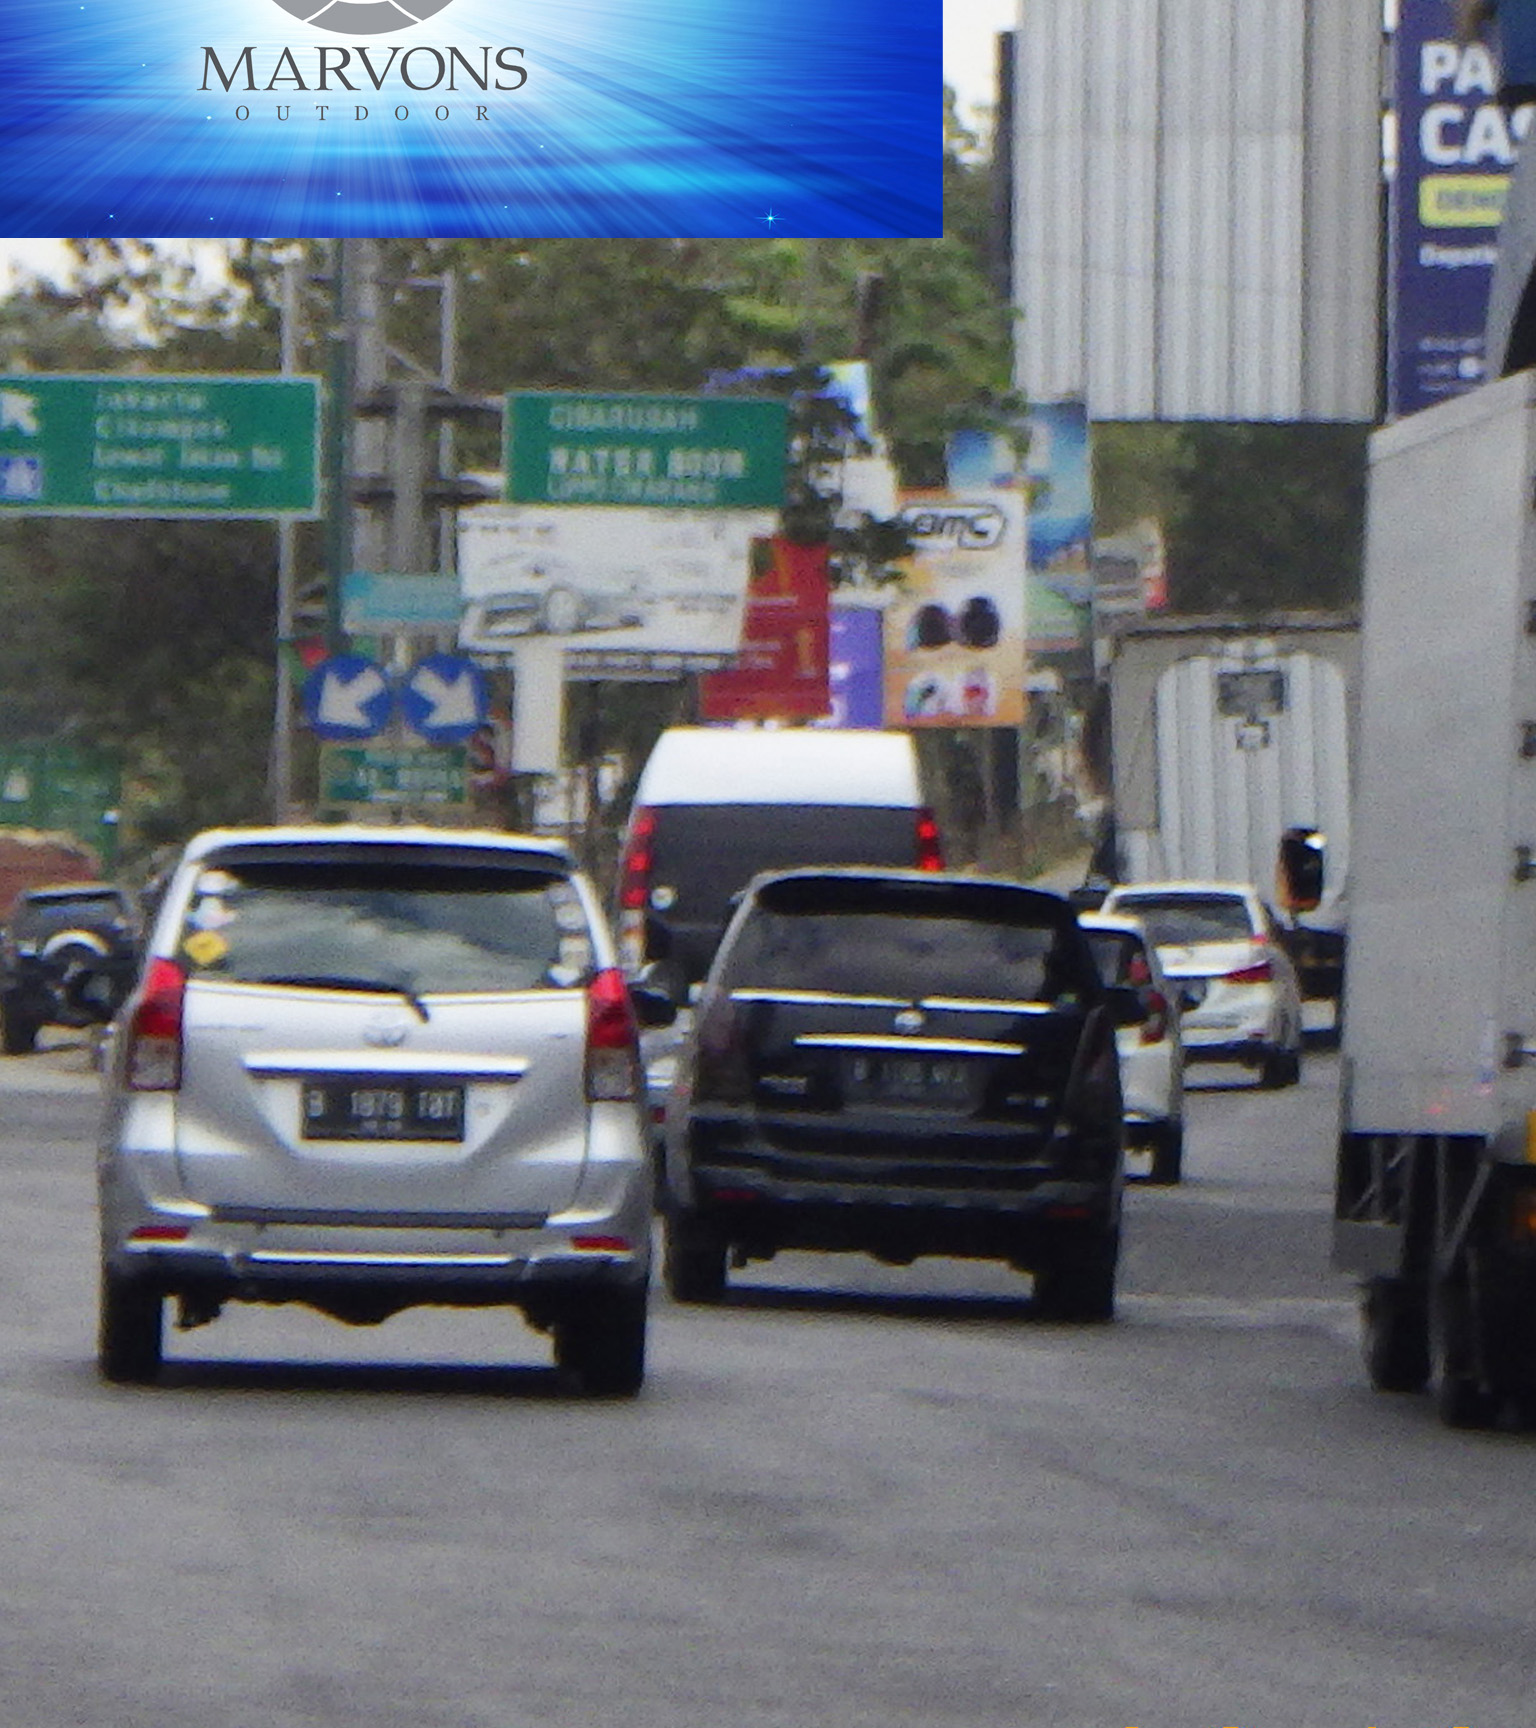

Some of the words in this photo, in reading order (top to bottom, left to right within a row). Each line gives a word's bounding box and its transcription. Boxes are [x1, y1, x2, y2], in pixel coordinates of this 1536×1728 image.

[197, 45, 528, 92] MARVONS
[1420, 42, 1495, 95] PA
[233, 104, 494, 122] OUTDOOR
